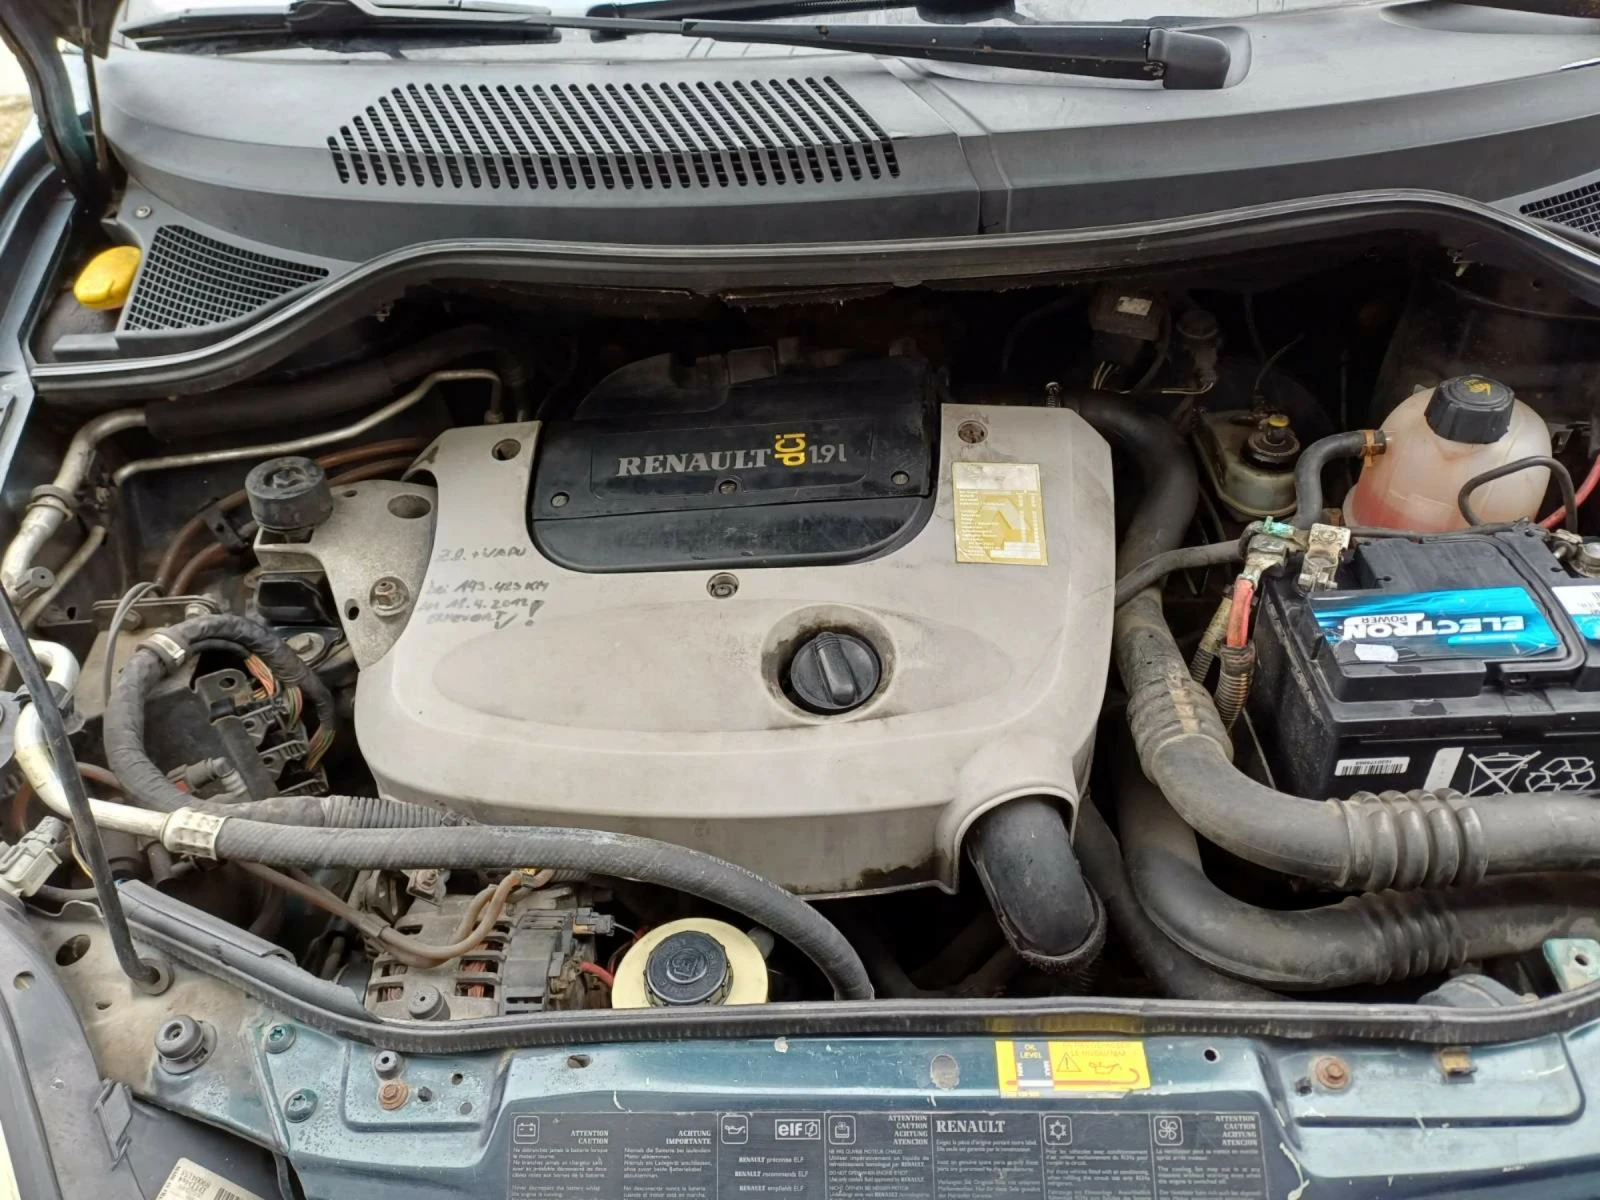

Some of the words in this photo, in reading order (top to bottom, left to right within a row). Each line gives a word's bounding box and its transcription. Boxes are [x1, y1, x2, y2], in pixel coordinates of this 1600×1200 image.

[616, 449, 771, 477] RENAULT
[774, 433, 806, 467] dCi
[1361, 615, 1408, 624] POWER
[1342, 615, 1524, 640] ELECTRON
[1020, 1051, 1042, 1059] LEVEL
[778, 1122, 803, 1137] elf
[936, 1120, 1006, 1133] RENAULT
[739, 1156, 765, 1164] RENAULT
[793, 1156, 804, 1164] ELF
